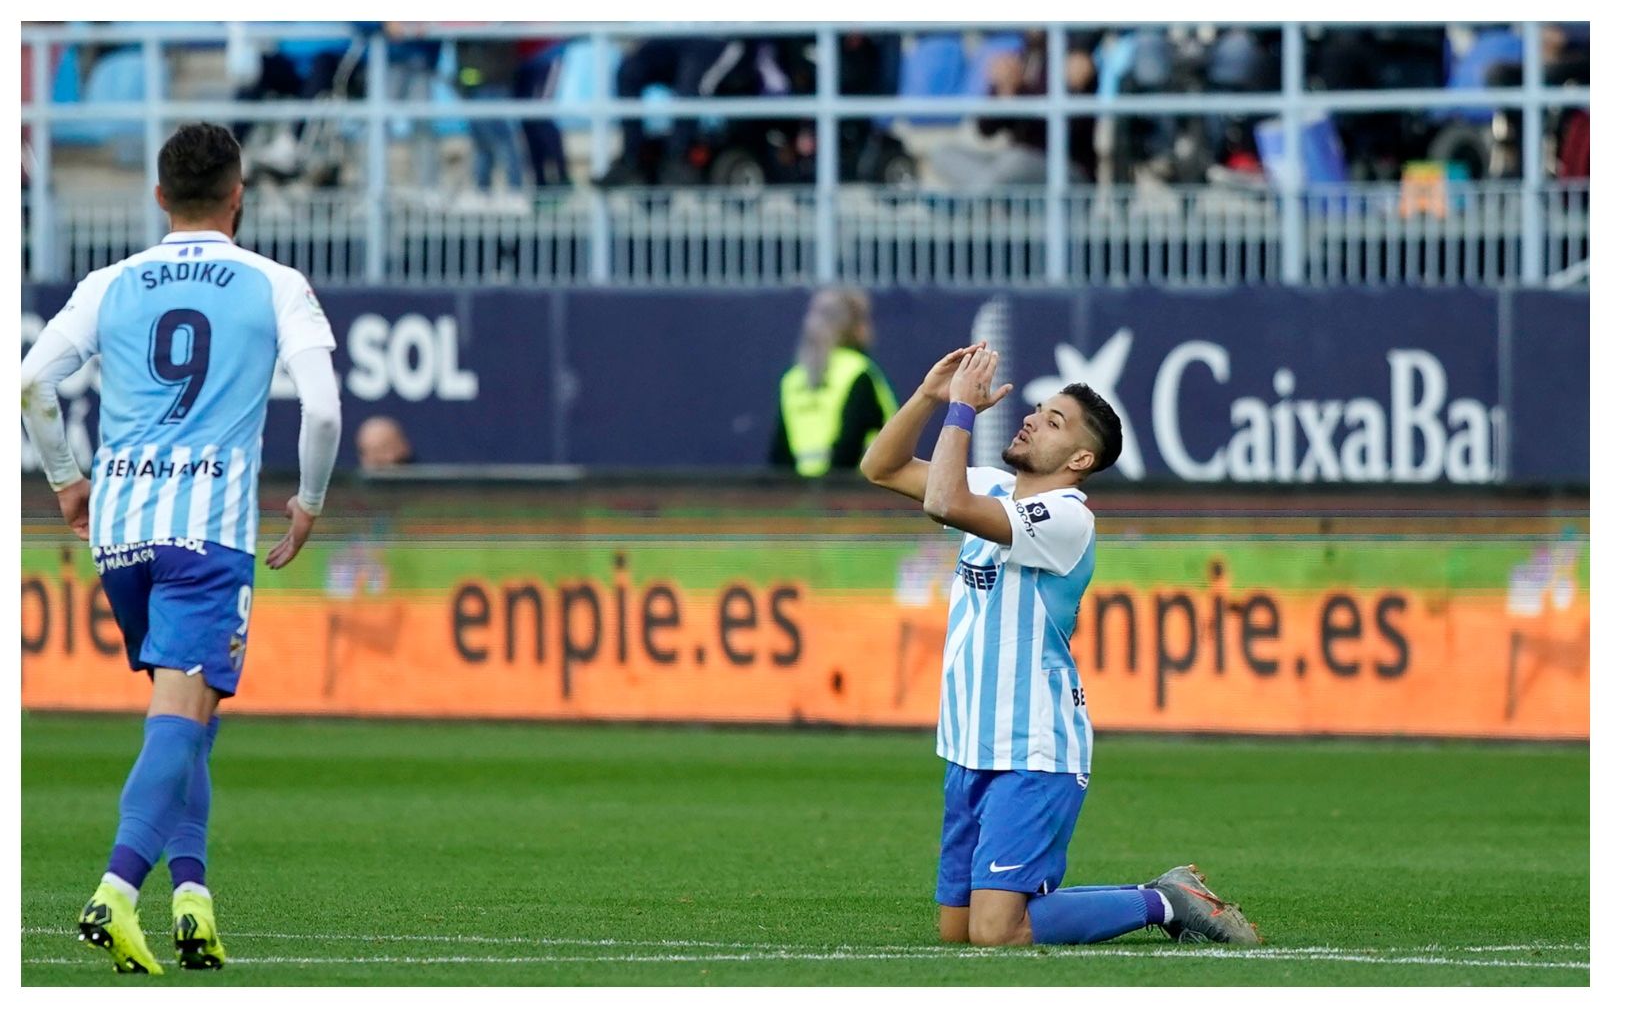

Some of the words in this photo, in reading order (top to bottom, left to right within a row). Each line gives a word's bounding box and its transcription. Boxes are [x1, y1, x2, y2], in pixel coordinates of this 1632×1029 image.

[141, 261, 236, 291] SADIKU
[148, 308, 212, 425] 9
[347, 312, 479, 402] SOL
[174, 536, 208, 556] SOL
[452, 552, 803, 700] enpie.es
[1092, 559, 1411, 712] npie.es
